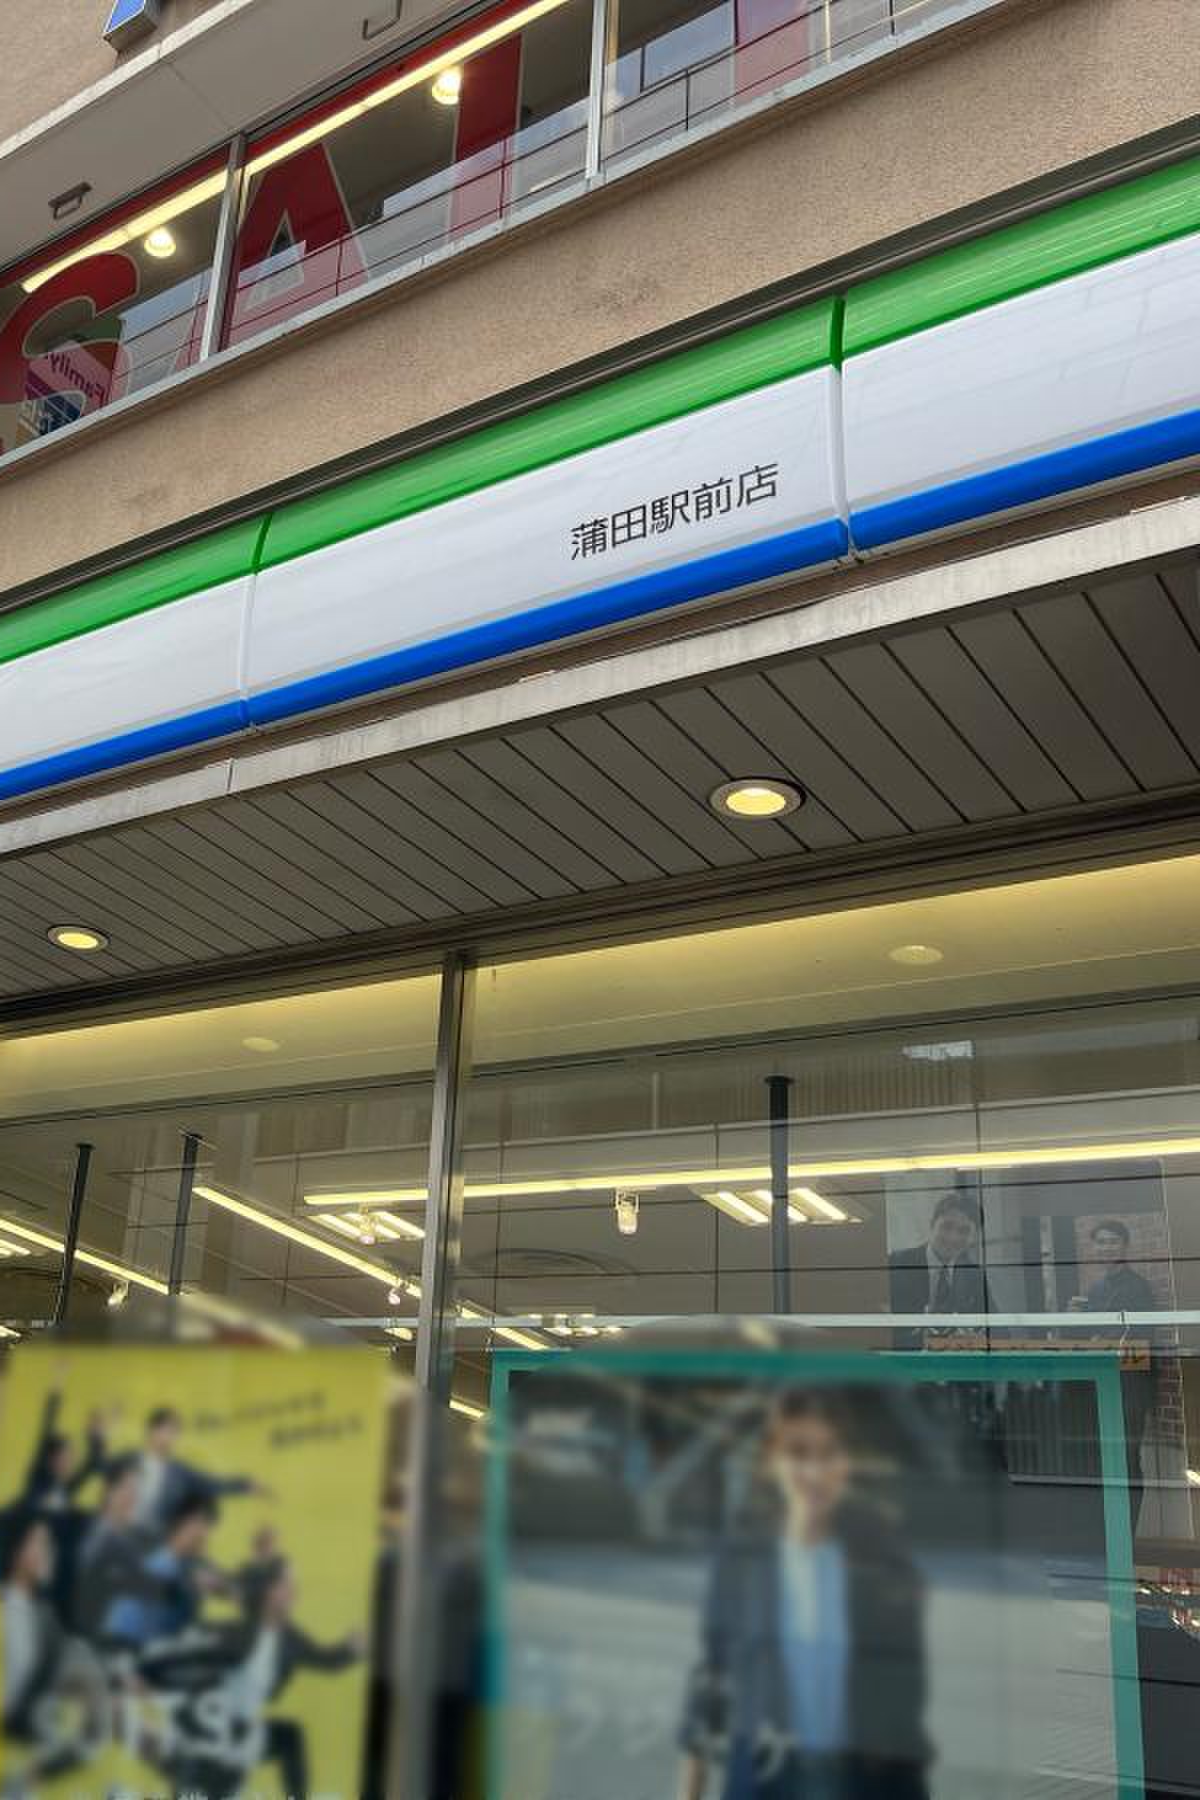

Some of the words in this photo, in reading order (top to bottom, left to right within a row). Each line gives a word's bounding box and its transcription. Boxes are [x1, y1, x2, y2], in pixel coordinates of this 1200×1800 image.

[571, 463, 778, 561] 蒲田駅前店
